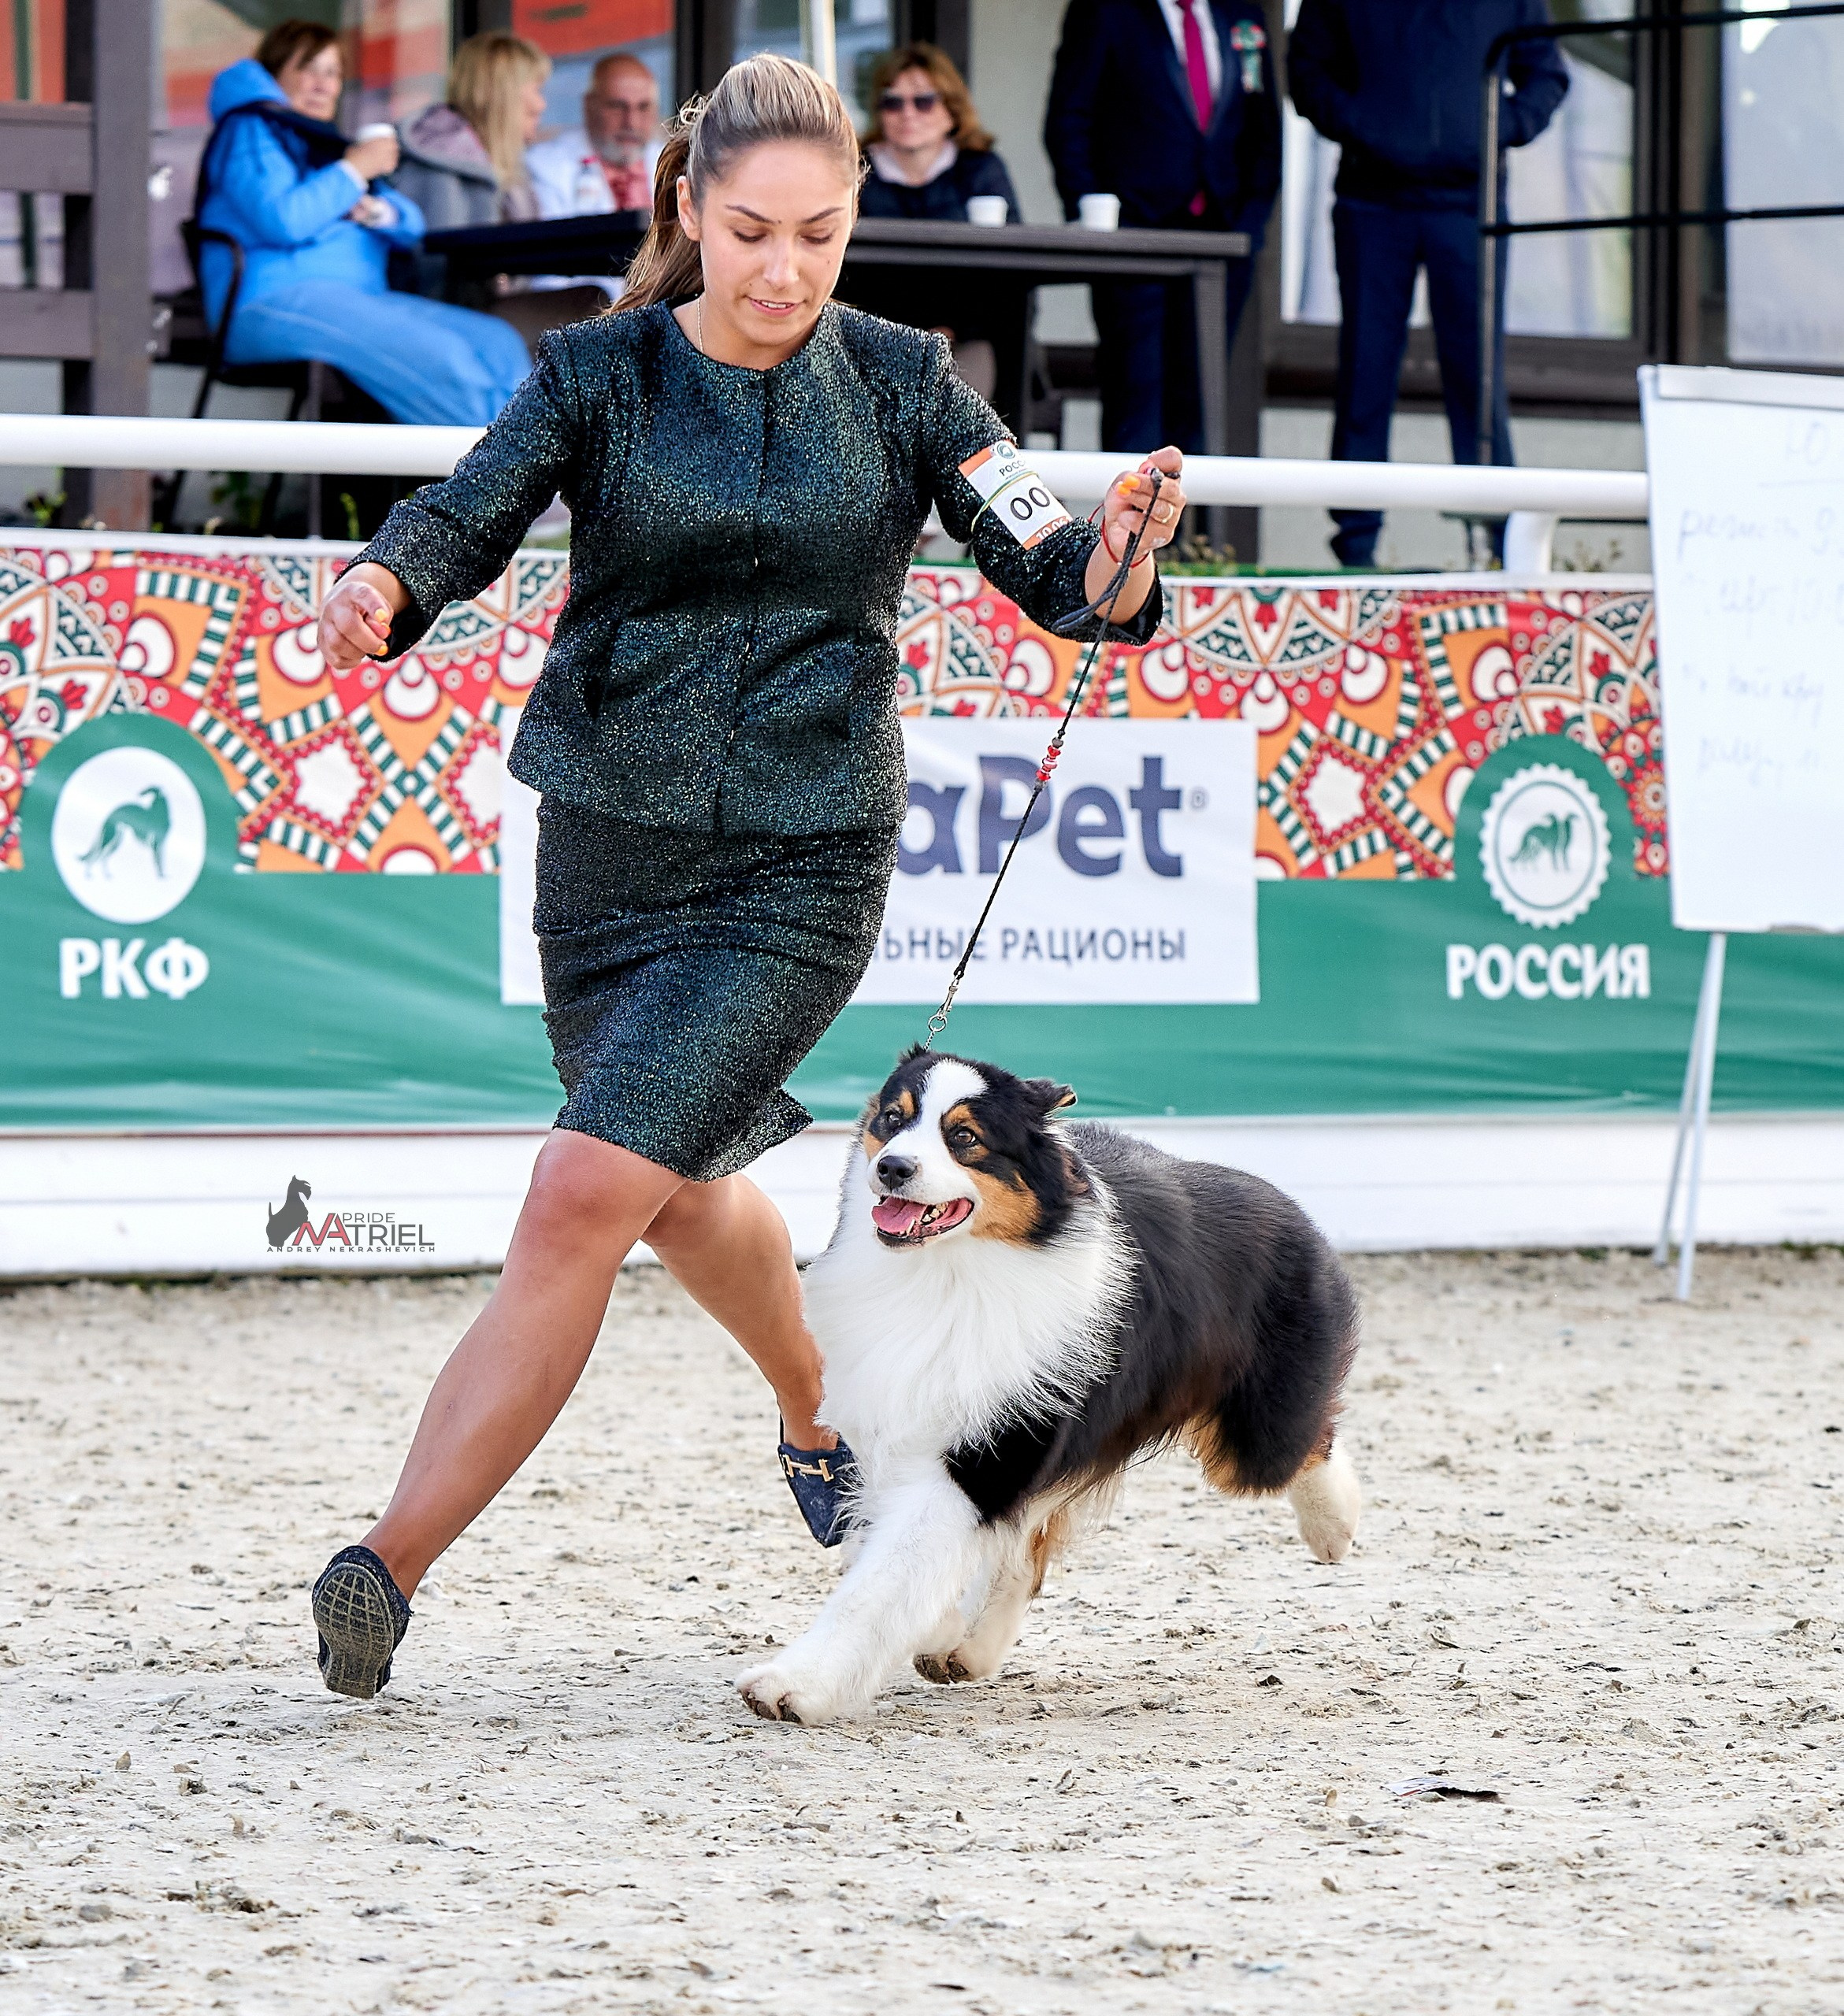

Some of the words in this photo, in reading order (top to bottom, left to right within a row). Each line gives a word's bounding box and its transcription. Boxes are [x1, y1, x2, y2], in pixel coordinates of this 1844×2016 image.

[999, 460, 1026, 476] РОСС
[59, 938, 210, 999] РКФ
[873, 927, 987, 960] ЬНЫЕ
[1001, 928, 1185, 967] РАЦИОНЫ
[1445, 943, 1651, 999] РОССИЯ
